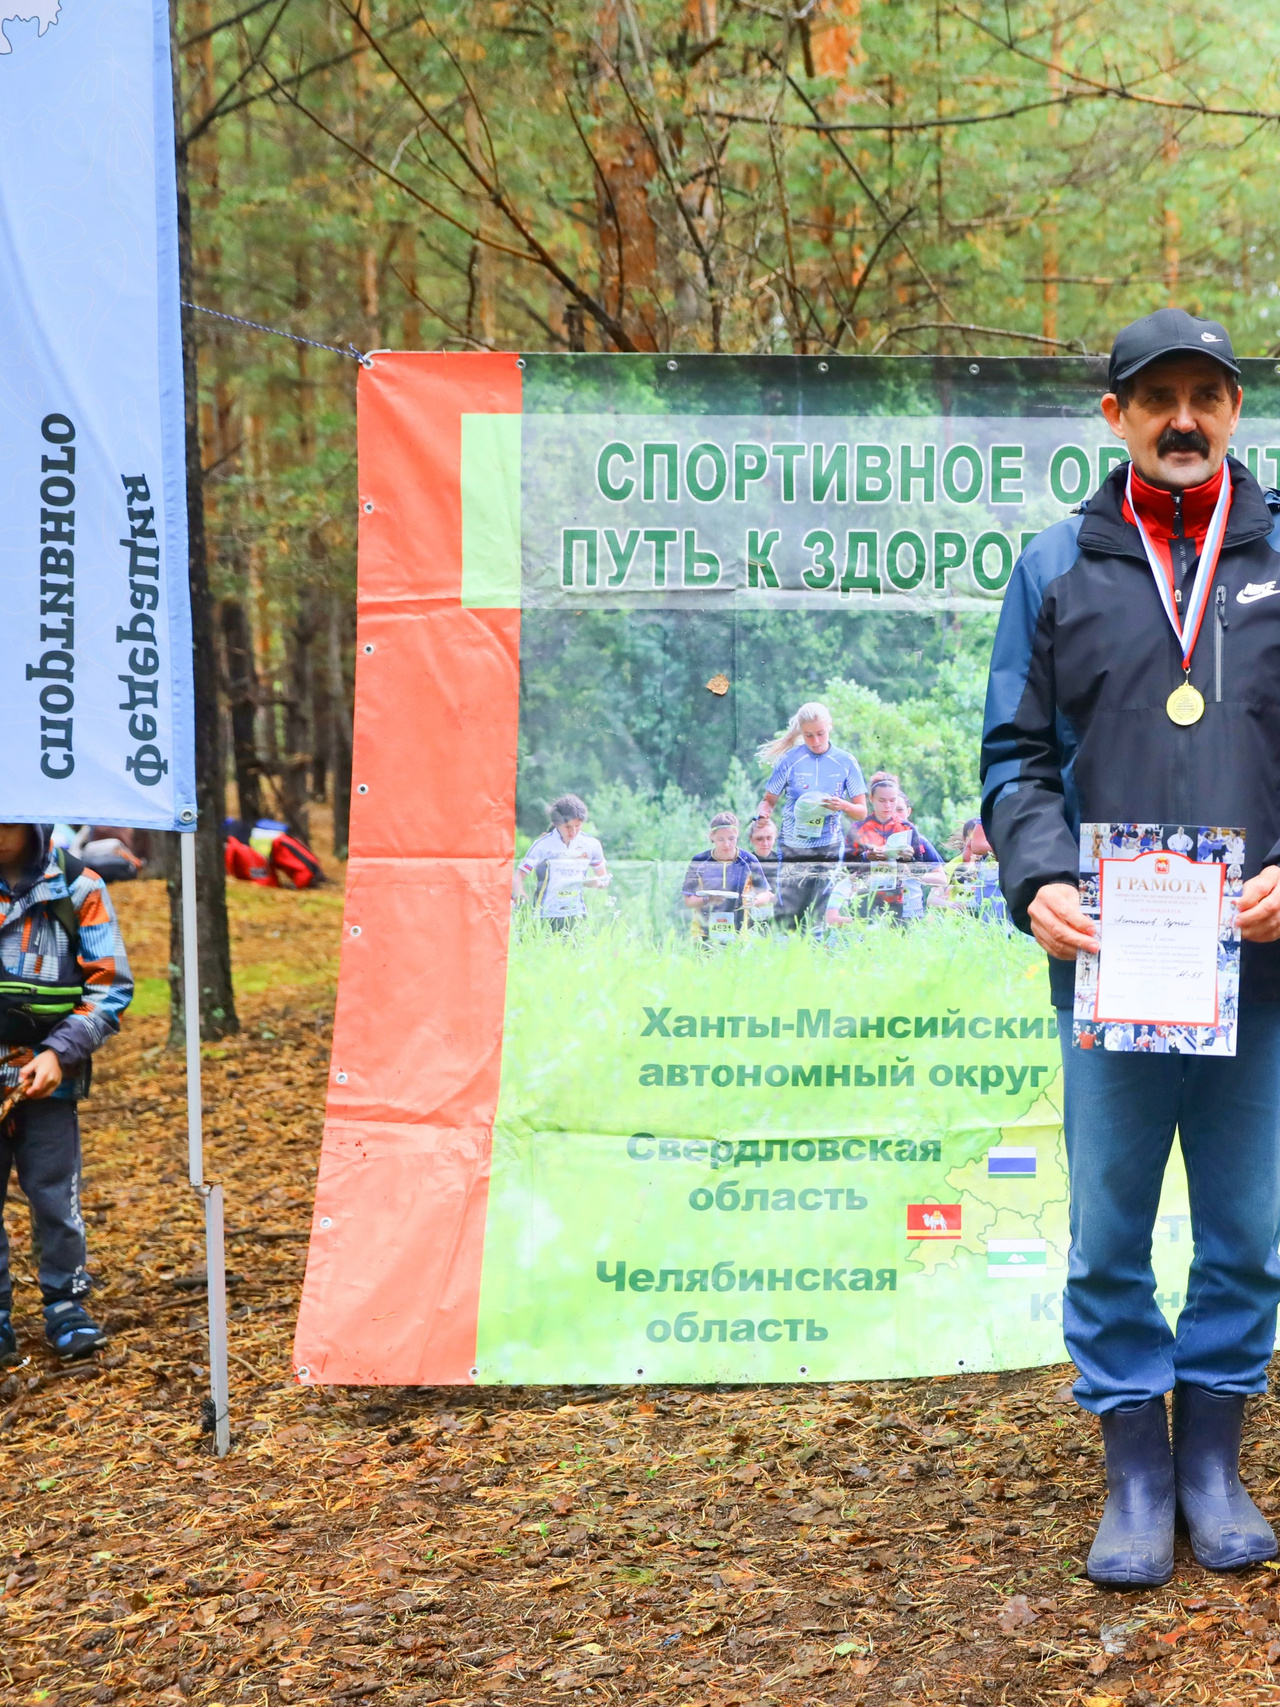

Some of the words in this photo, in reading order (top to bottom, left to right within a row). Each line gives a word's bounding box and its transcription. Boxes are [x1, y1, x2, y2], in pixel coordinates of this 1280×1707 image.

[598, 442, 1025, 503] СПОРТИВНОЕ
[562, 528, 722, 588] ПУТЬ
[746, 529, 781, 589] К
[801, 529, 1036, 600] ЗДОРО
[1115, 876, 1207, 894] ГРАМОТА
[638, 1056, 915, 1087] автономный
[928, 1063, 1048, 1095] округ
[627, 1132, 942, 1170] Свердловская
[688, 1180, 869, 1212] область
[596, 1259, 898, 1292] Челябинская
[646, 1311, 829, 1343] область
